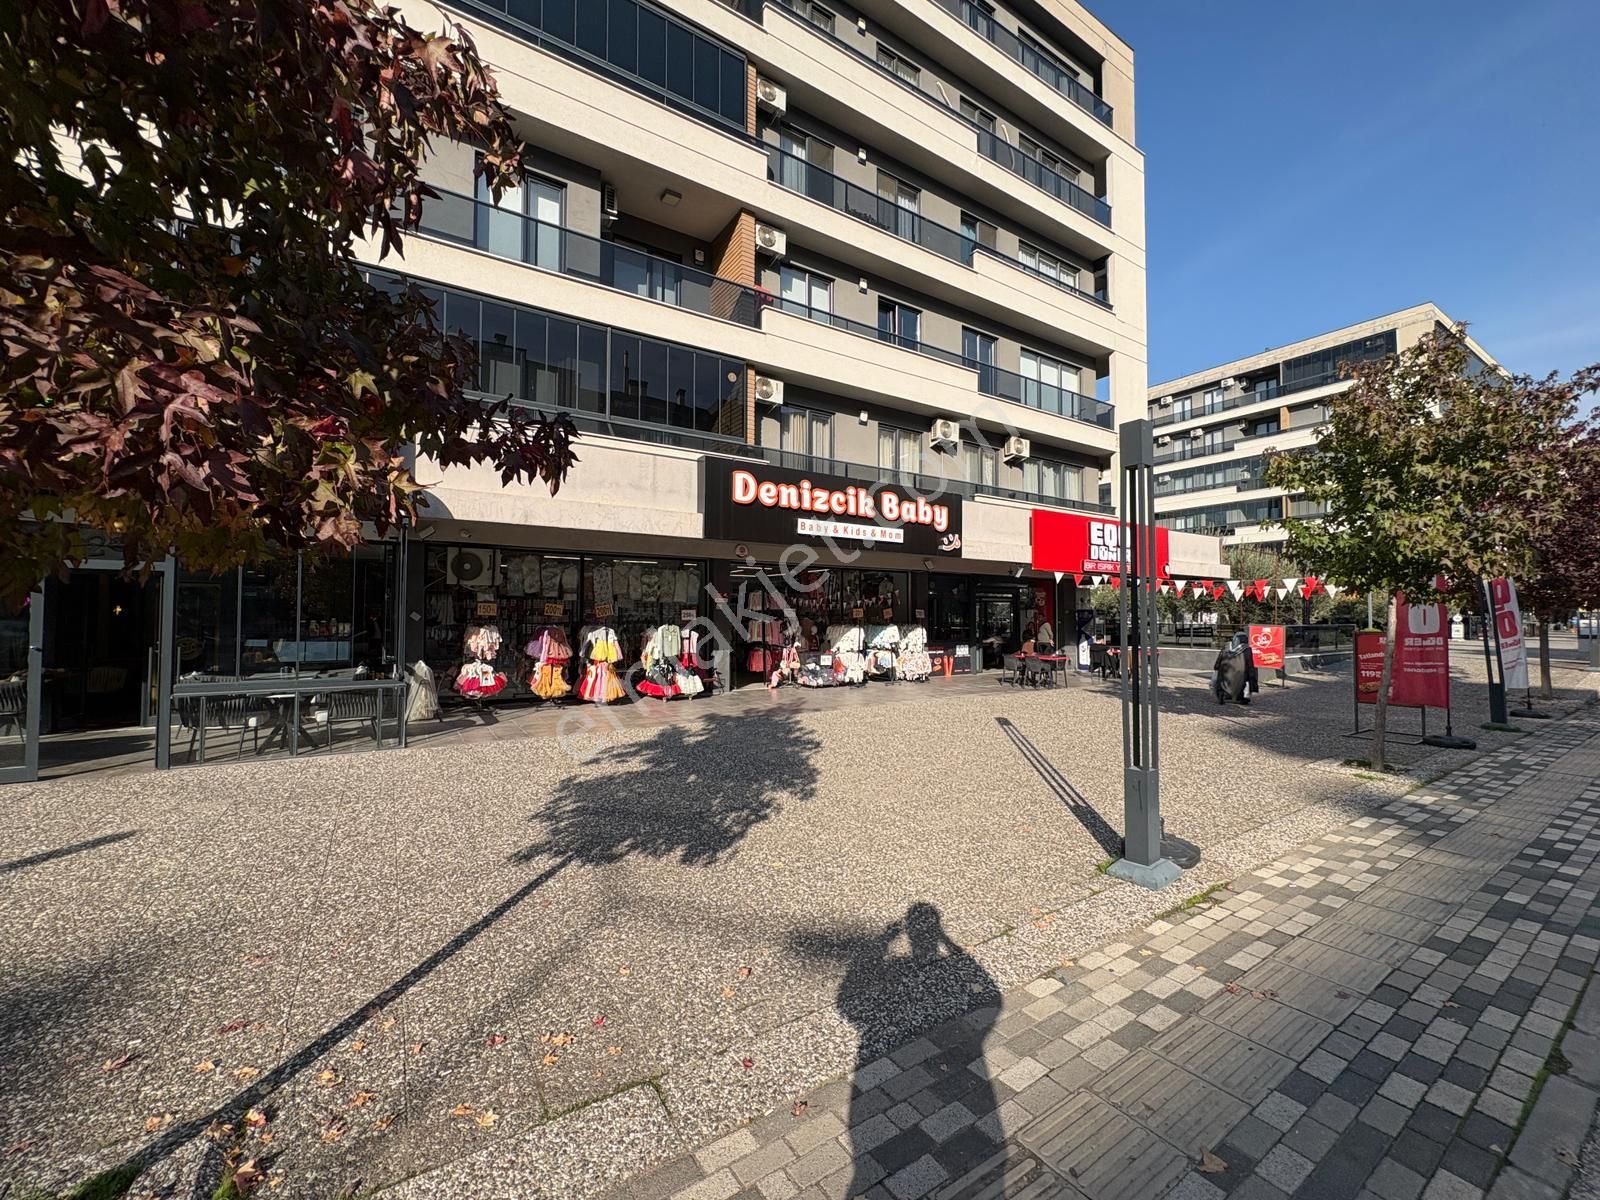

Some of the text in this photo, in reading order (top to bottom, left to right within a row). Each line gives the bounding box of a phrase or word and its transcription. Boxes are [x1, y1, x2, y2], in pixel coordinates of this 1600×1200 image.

[732, 470, 949, 532] Denizcik Baby
[800, 521, 903, 541] Baby & Kids & Mom
